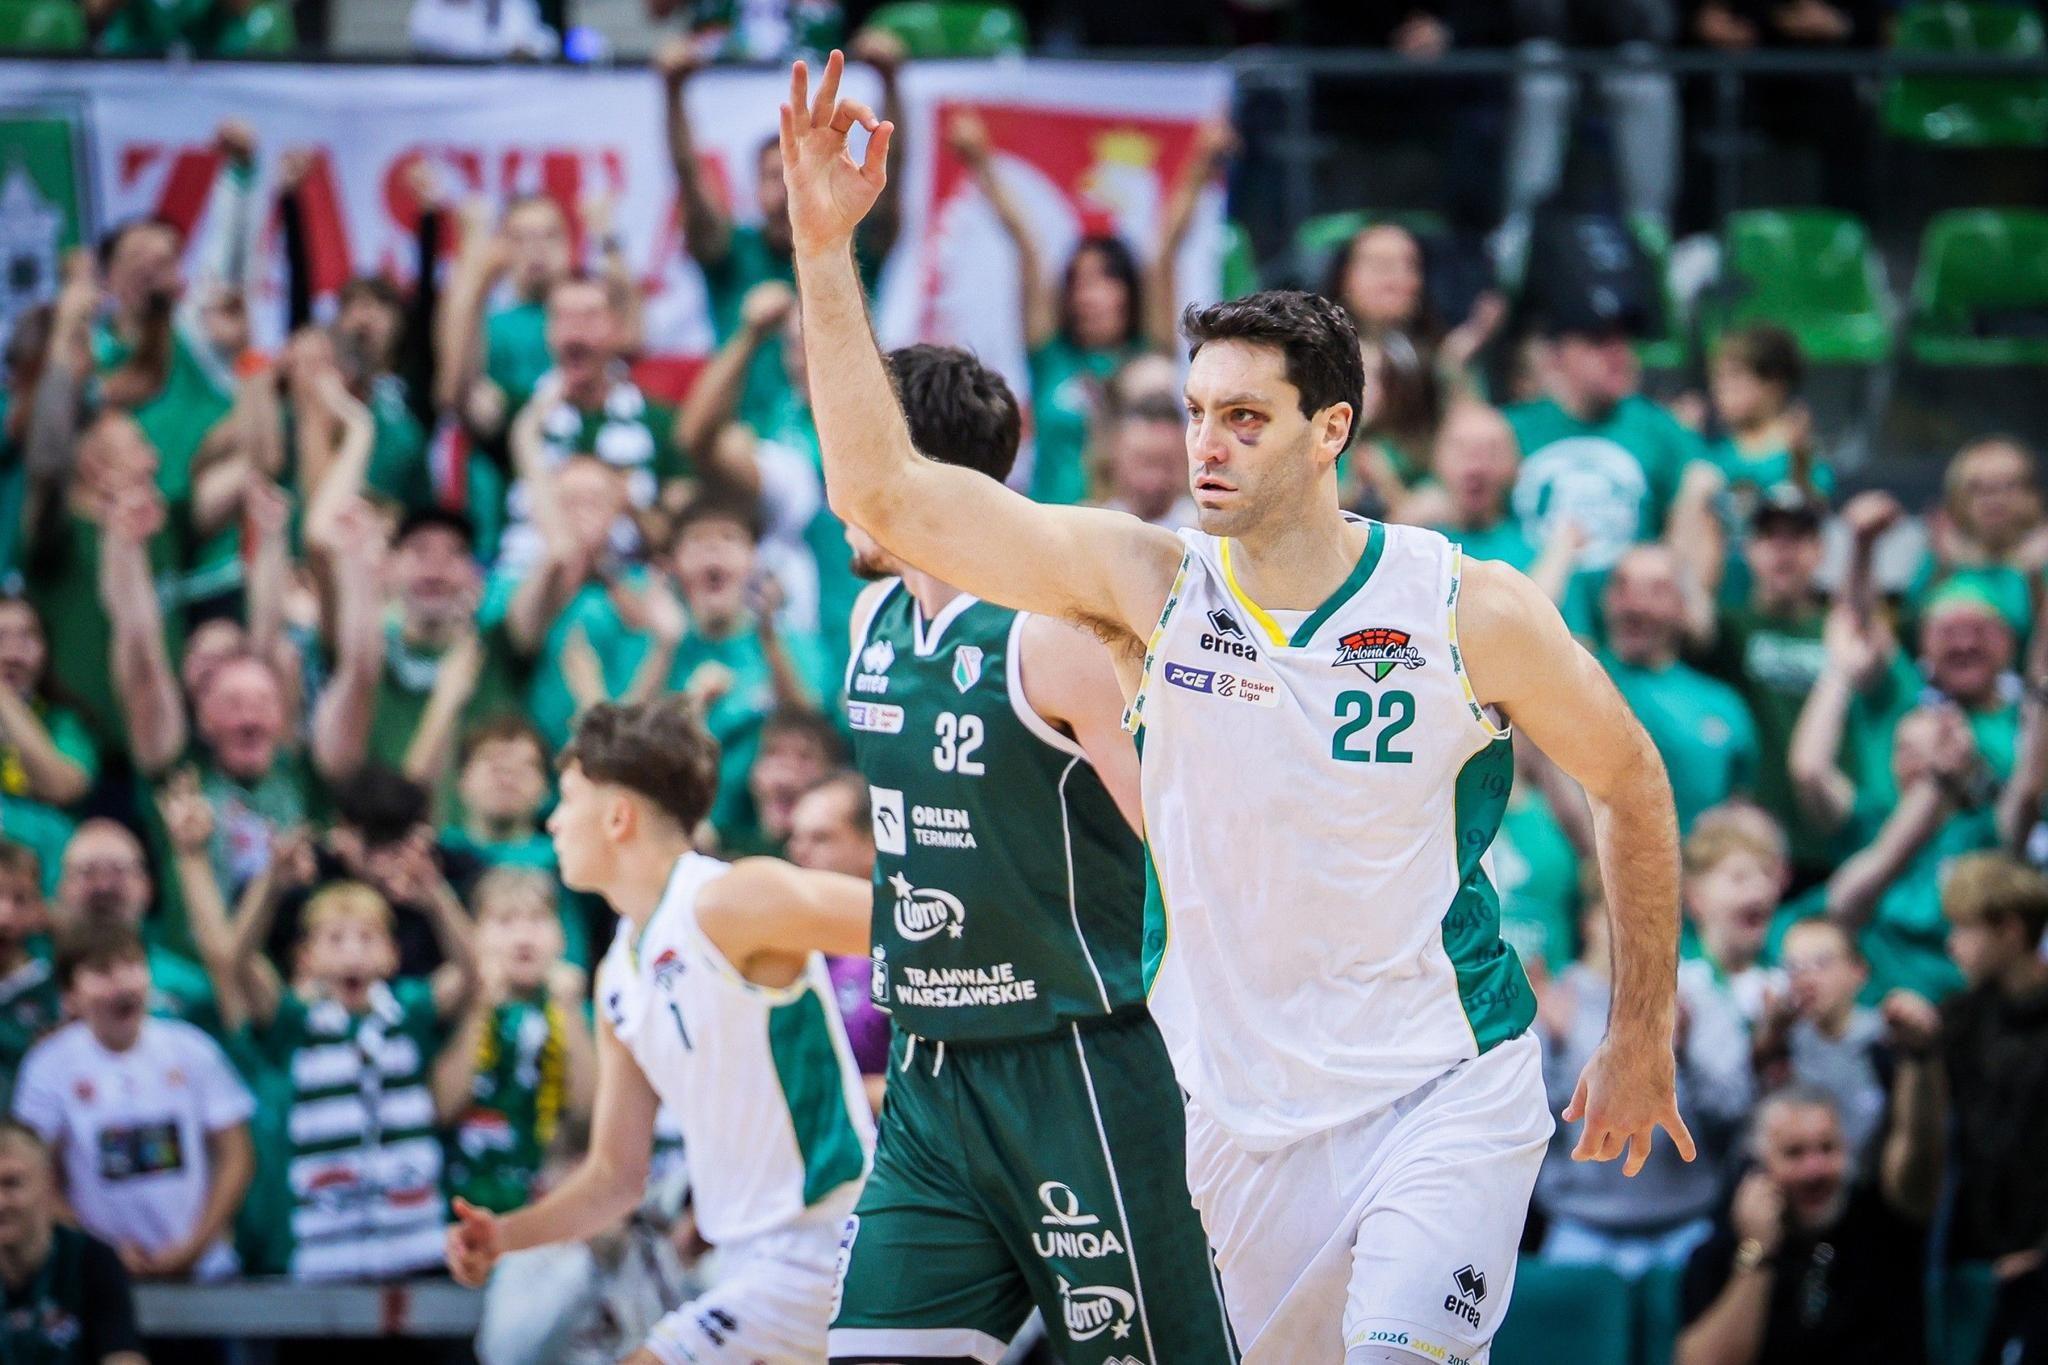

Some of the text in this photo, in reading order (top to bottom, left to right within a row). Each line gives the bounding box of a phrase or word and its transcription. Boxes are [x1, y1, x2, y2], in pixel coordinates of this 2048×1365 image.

[1200, 632, 1257, 662] errea
[1170, 667, 1209, 689] PGE
[1240, 679, 1274, 693] Basket
[1239, 689, 1260, 701] Liga
[1332, 690, 1416, 764] 22
[932, 711, 985, 776] 32
[911, 805, 970, 829] ORLEN
[912, 828, 977, 849] TERMIKA
[902, 899, 948, 931] LOTTO
[904, 963, 1016, 987] TRAMWAJE
[895, 980, 1038, 1007] WARSZAWSKIE
[669, 1002, 694, 1051] 1
[1031, 1229, 1125, 1259] UNIQA
[1065, 1297, 1113, 1331] LOTTO
[1444, 1294, 1481, 1331] errea
[1368, 1330, 1409, 1345] 2026
[1411, 1339, 1446, 1360] 2026
